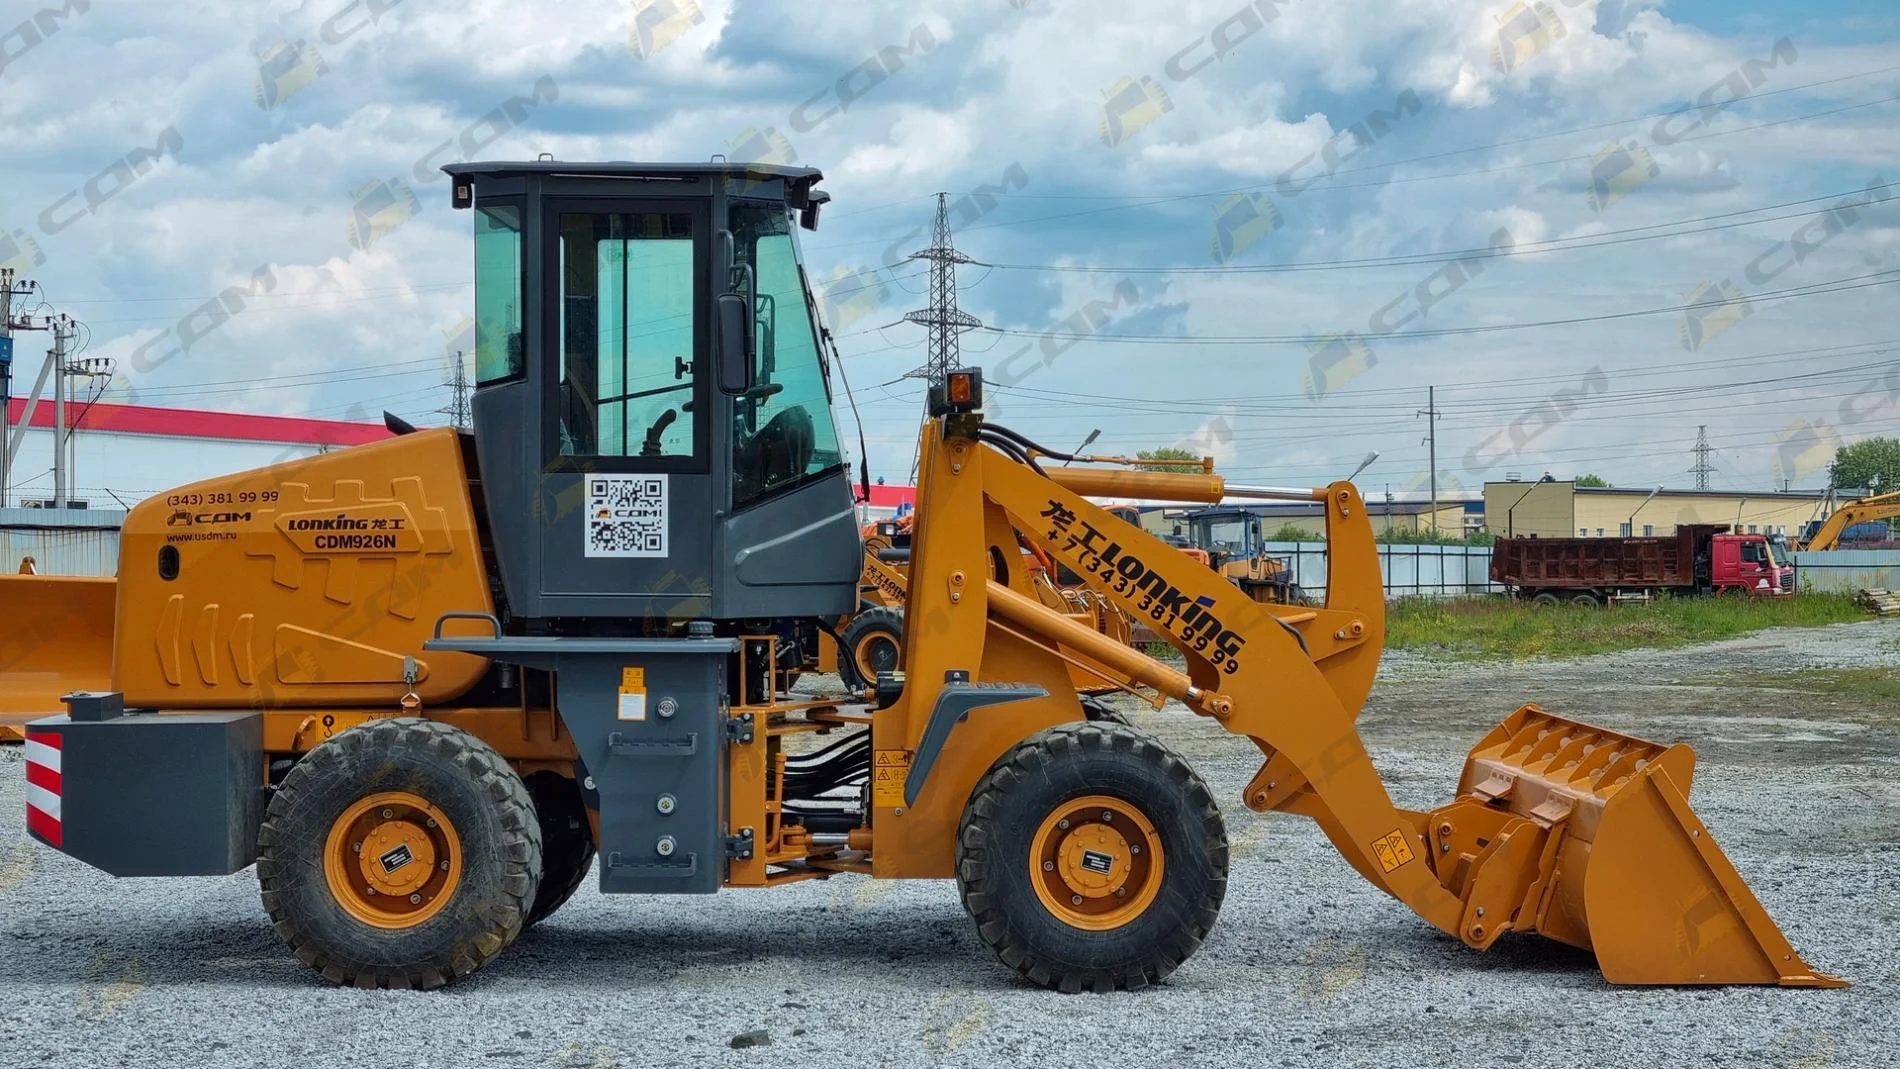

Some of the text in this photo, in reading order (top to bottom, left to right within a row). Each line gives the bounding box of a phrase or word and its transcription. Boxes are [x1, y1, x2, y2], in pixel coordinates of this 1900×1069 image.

[168, 490, 279, 507] (343) 381 99 99
[371, 519, 405, 530] 龙工
[1040, 500, 1107, 559] 龙工
[167, 532, 237, 542] www.usdm.ru
[315, 535, 396, 549] CDM926N
[1077, 547, 1136, 599] (343)
[1136, 594, 1178, 632] 381
[1180, 626, 1209, 656] 99
[1210, 651, 1239, 675] 99
